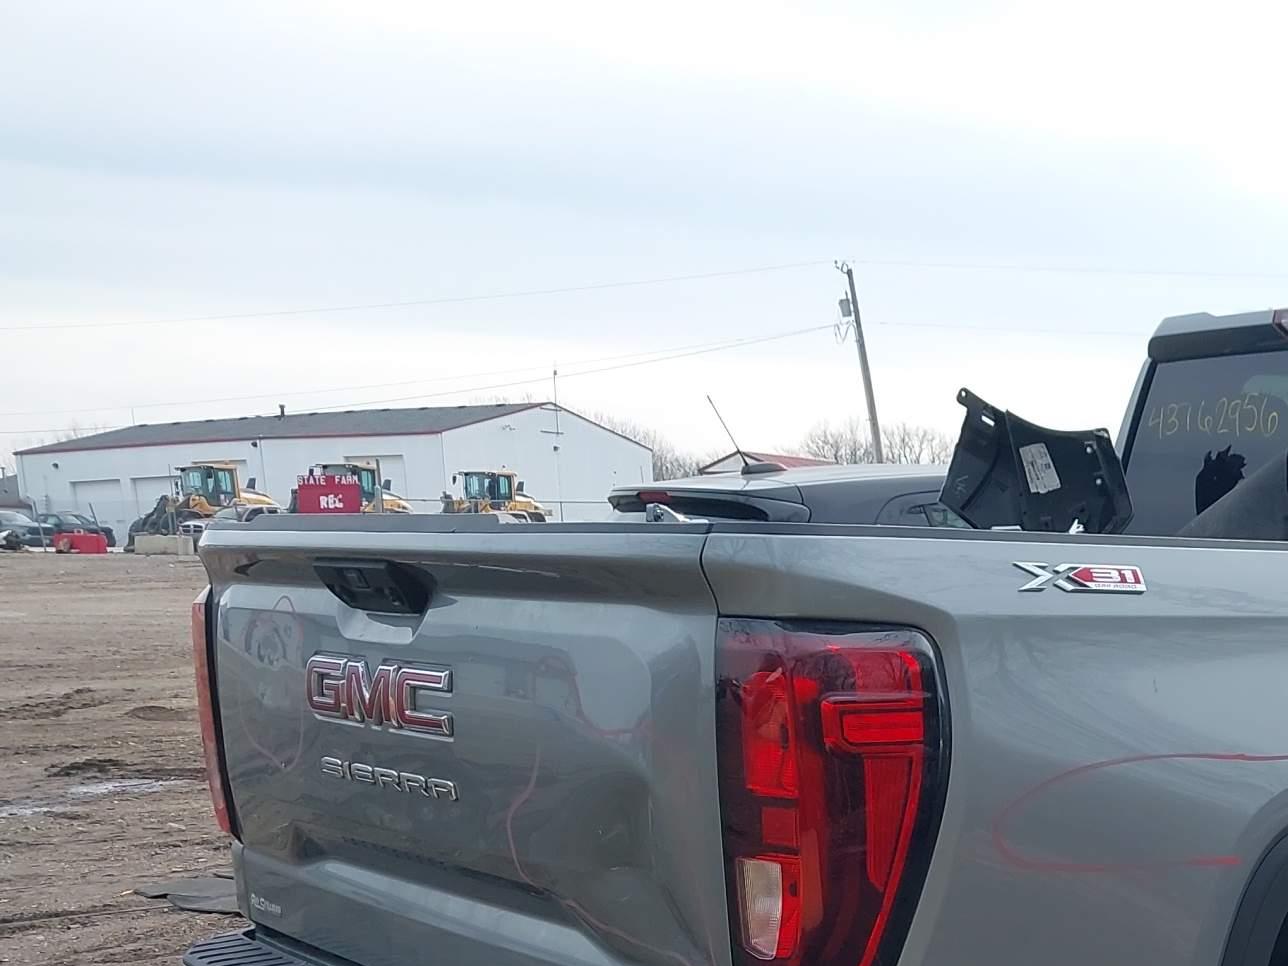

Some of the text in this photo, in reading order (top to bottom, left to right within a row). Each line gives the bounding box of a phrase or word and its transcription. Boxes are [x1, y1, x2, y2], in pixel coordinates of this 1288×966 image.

[297, 474, 360, 486] STATE FARM
[305, 653, 454, 739] GMC
[320, 756, 459, 801] SIERRA
